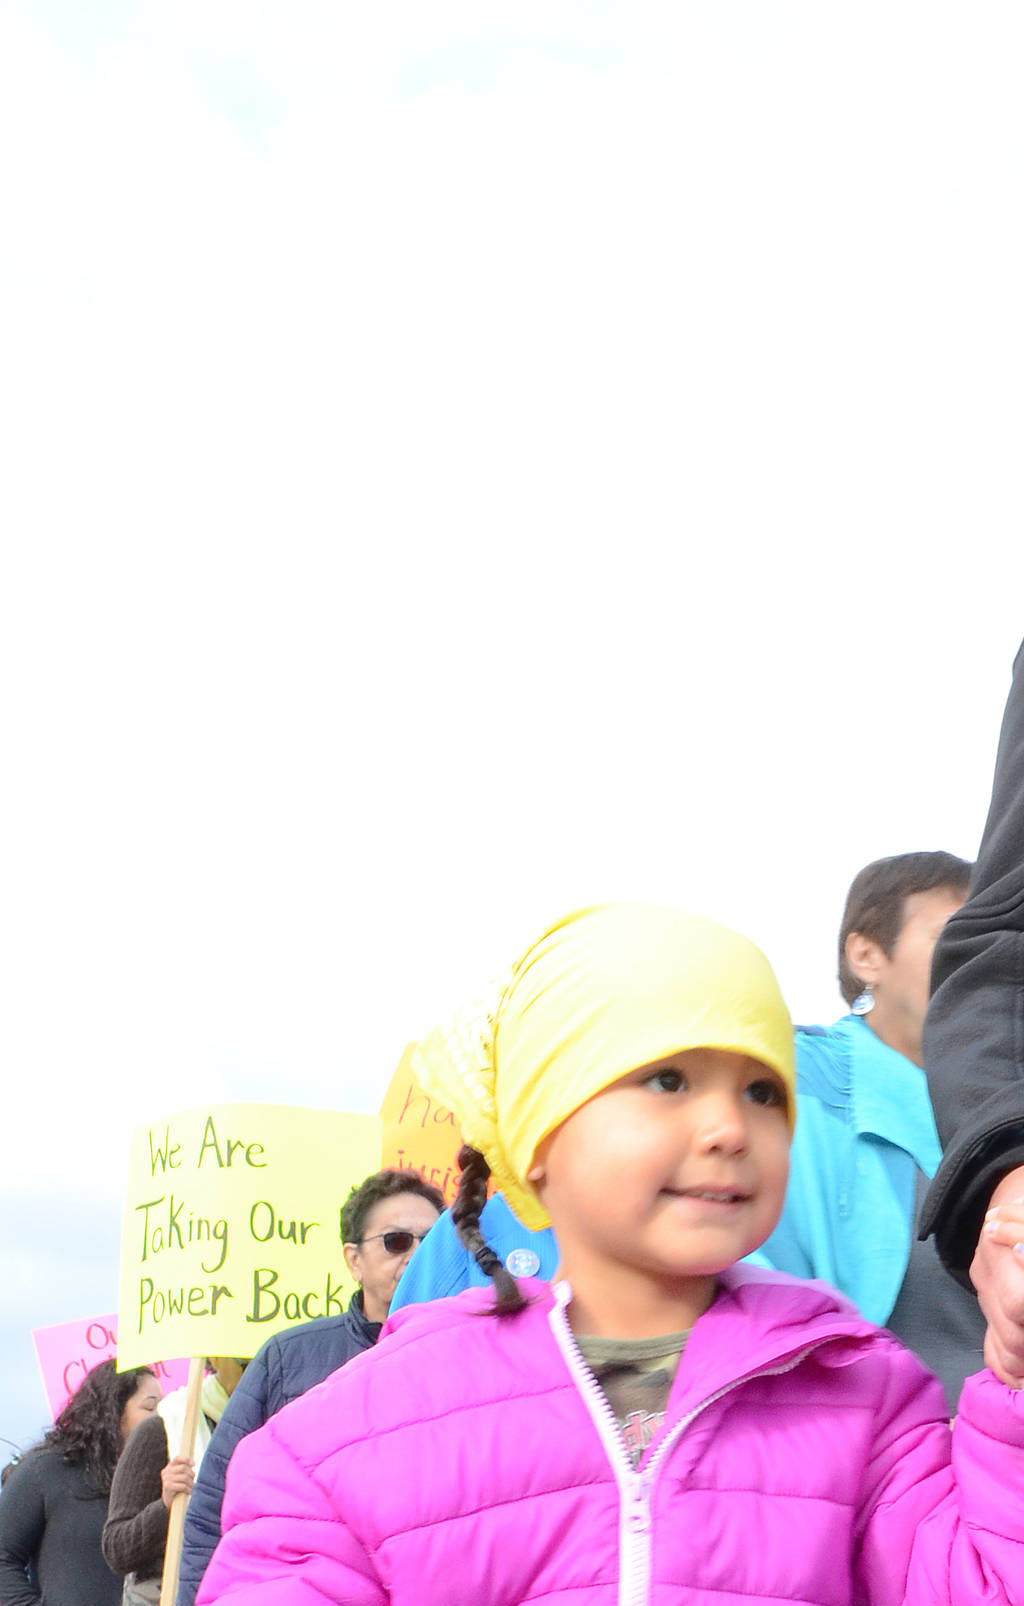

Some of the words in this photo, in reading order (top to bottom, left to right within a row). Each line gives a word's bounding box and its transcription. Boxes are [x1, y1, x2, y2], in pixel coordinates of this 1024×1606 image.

[148, 1124, 183, 1177] We
[197, 1115, 269, 1169] Are
[135, 1194, 229, 1273] Taking
[249, 1200, 320, 1245] Our
[138, 1277, 234, 1335] Power
[245, 1268, 345, 1323] Back
